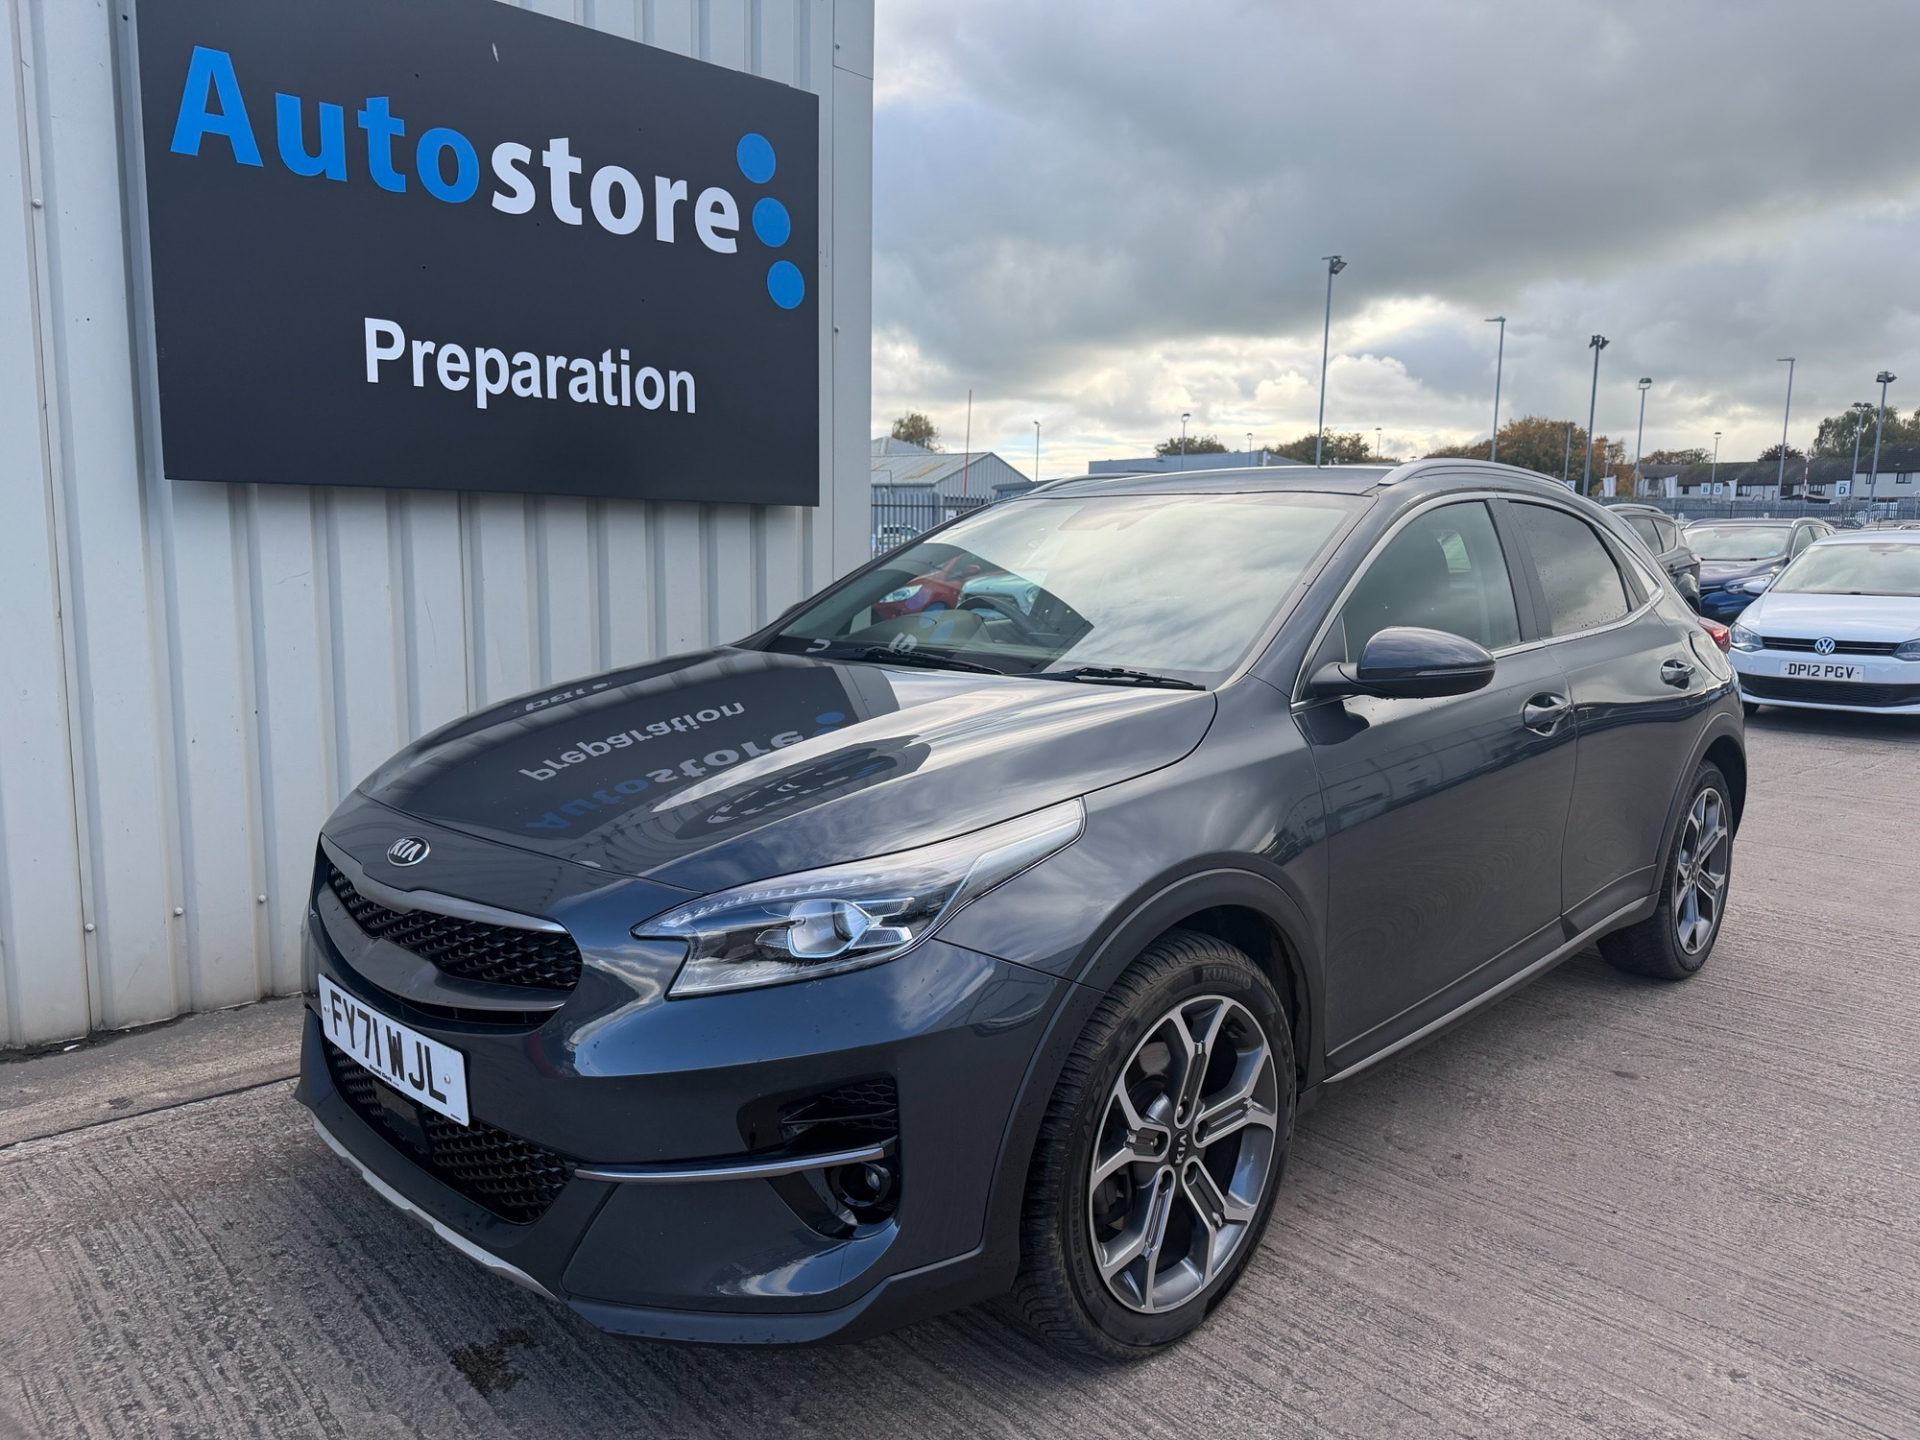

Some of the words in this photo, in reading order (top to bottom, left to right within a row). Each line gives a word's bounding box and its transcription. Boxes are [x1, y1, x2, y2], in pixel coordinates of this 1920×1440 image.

[170, 45, 740, 254] Autostore
[363, 317, 696, 414] Preparation
[1839, 486, 1846, 495] D
[1788, 663, 1820, 677] DP12
[1824, 665, 1854, 679] PGV
[390, 838, 422, 861] KIA
[1203, 967, 1251, 990] KUMHO
[330, 988, 382, 1068] FY71
[386, 1024, 447, 1105] WJL
[1175, 1134, 1187, 1163] KIA
